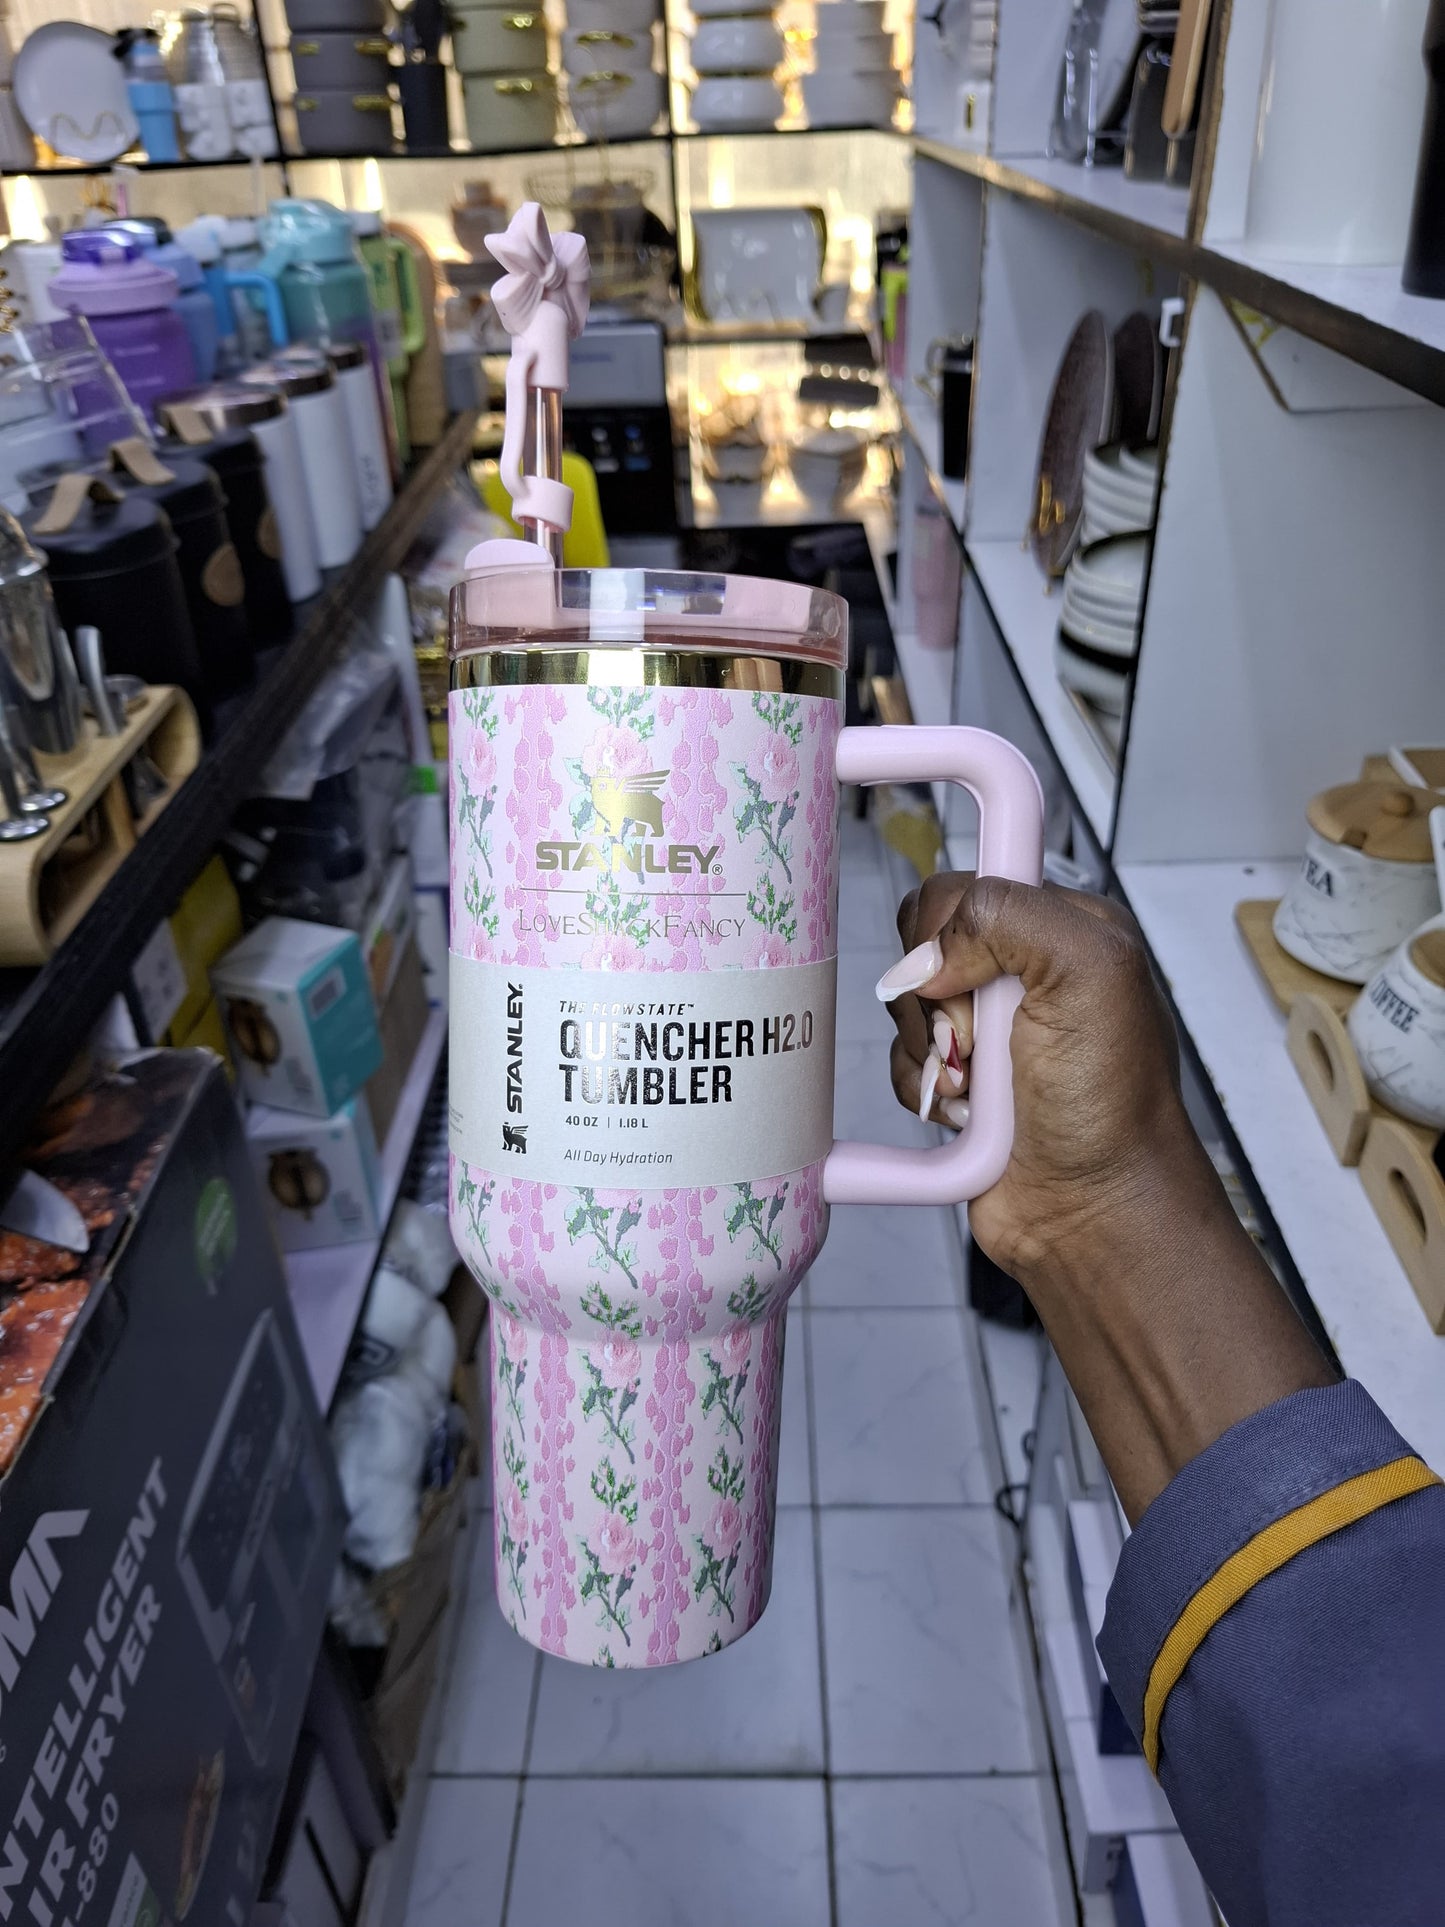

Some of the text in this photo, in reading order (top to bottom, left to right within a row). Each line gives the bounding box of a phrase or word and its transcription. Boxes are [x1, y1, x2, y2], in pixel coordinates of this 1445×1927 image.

[559, 1001, 586, 1014] THE
[1370, 974, 1420, 1033] OFFEE
[559, 1010, 814, 1062] QUENCHER H2.0
[558, 1064, 733, 1106] TUMBLER
[565, 1115, 649, 1129] 40 OZ 1.18 L
[563, 1149, 673, 1166] All Day Hydration
[0, 1455, 167, 1924] NTELLIGENT
[27, 1827, 76, 1927] IR
[65, 1583, 162, 1830] FRYER
